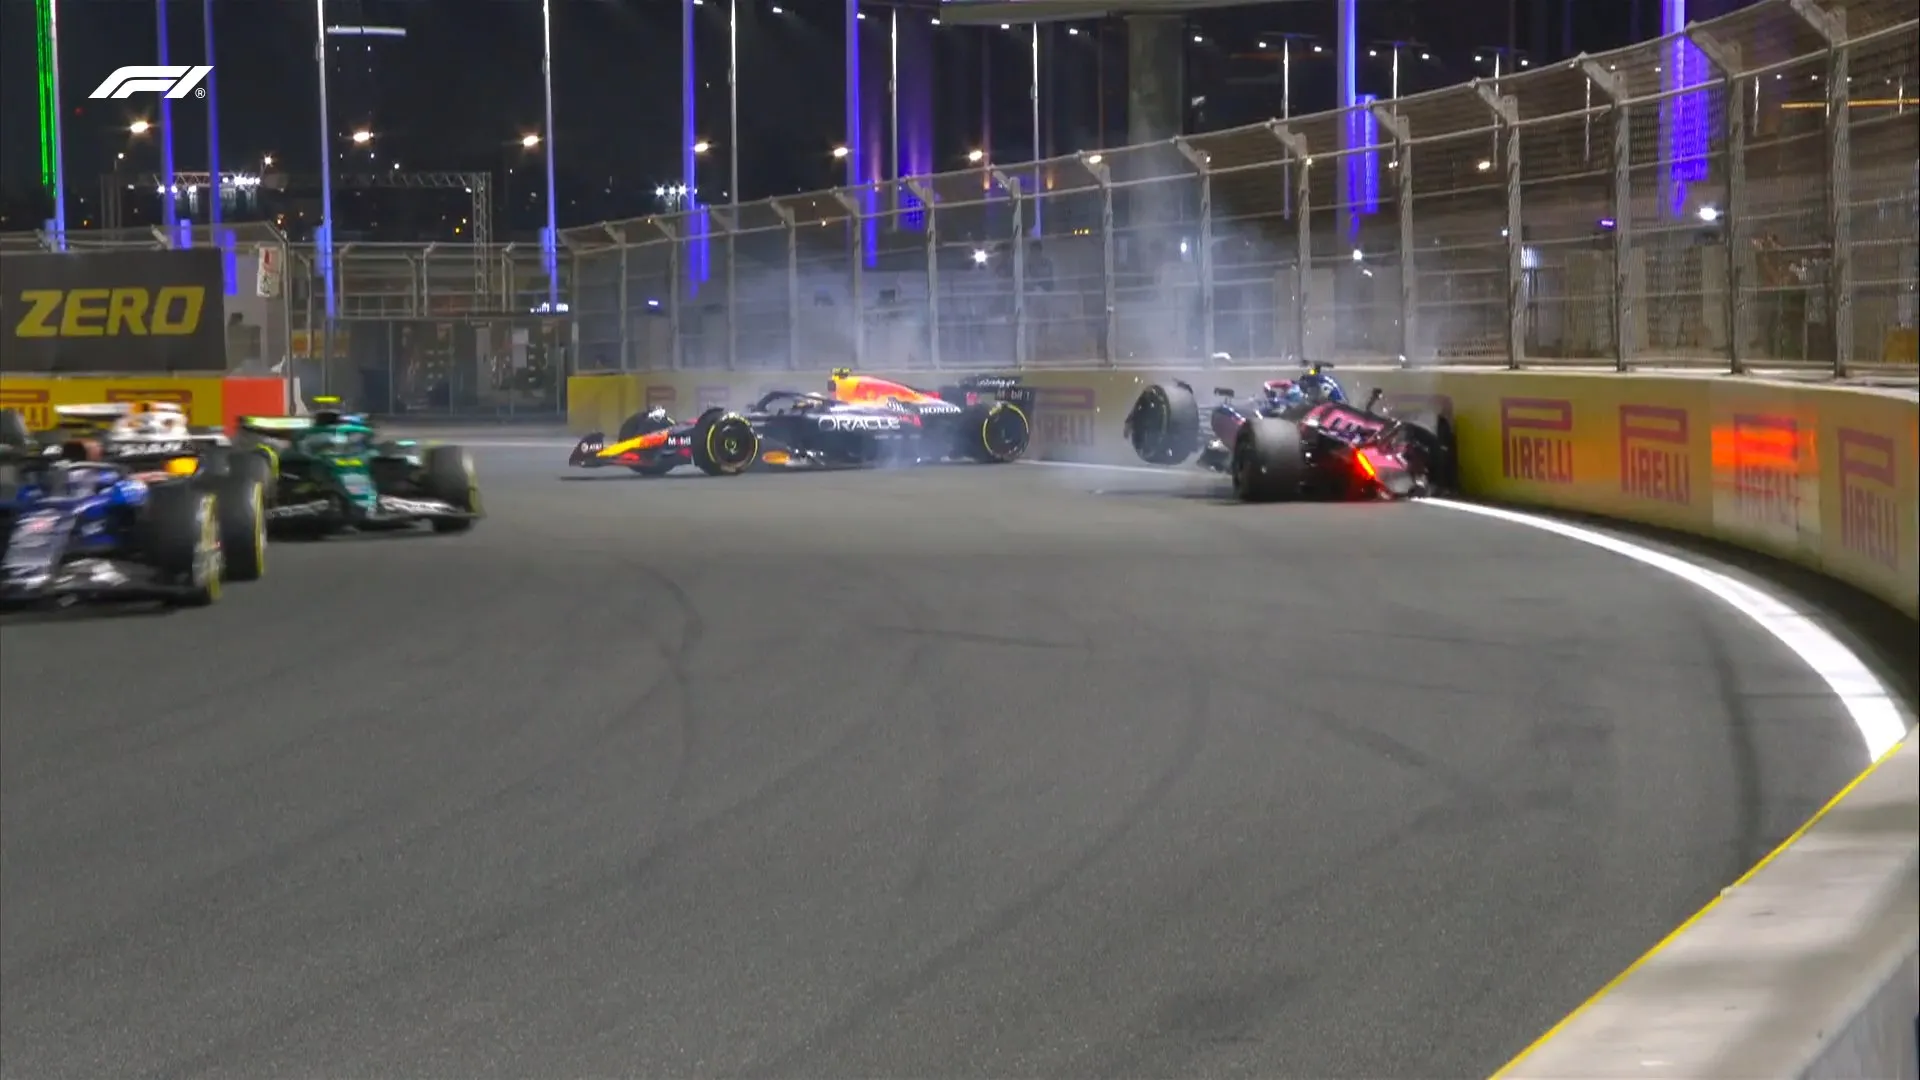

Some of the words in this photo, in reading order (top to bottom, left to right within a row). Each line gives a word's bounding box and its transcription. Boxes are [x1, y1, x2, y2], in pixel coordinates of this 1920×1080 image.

[16, 286, 205, 337] ZERO
[818, 415, 901, 432] ORACLE
[919, 405, 963, 416] HONDA
[1501, 397, 1573, 484] PIRELLI
[1619, 404, 1691, 506] PIRELLI
[1837, 427, 1898, 573] PIRELLI
